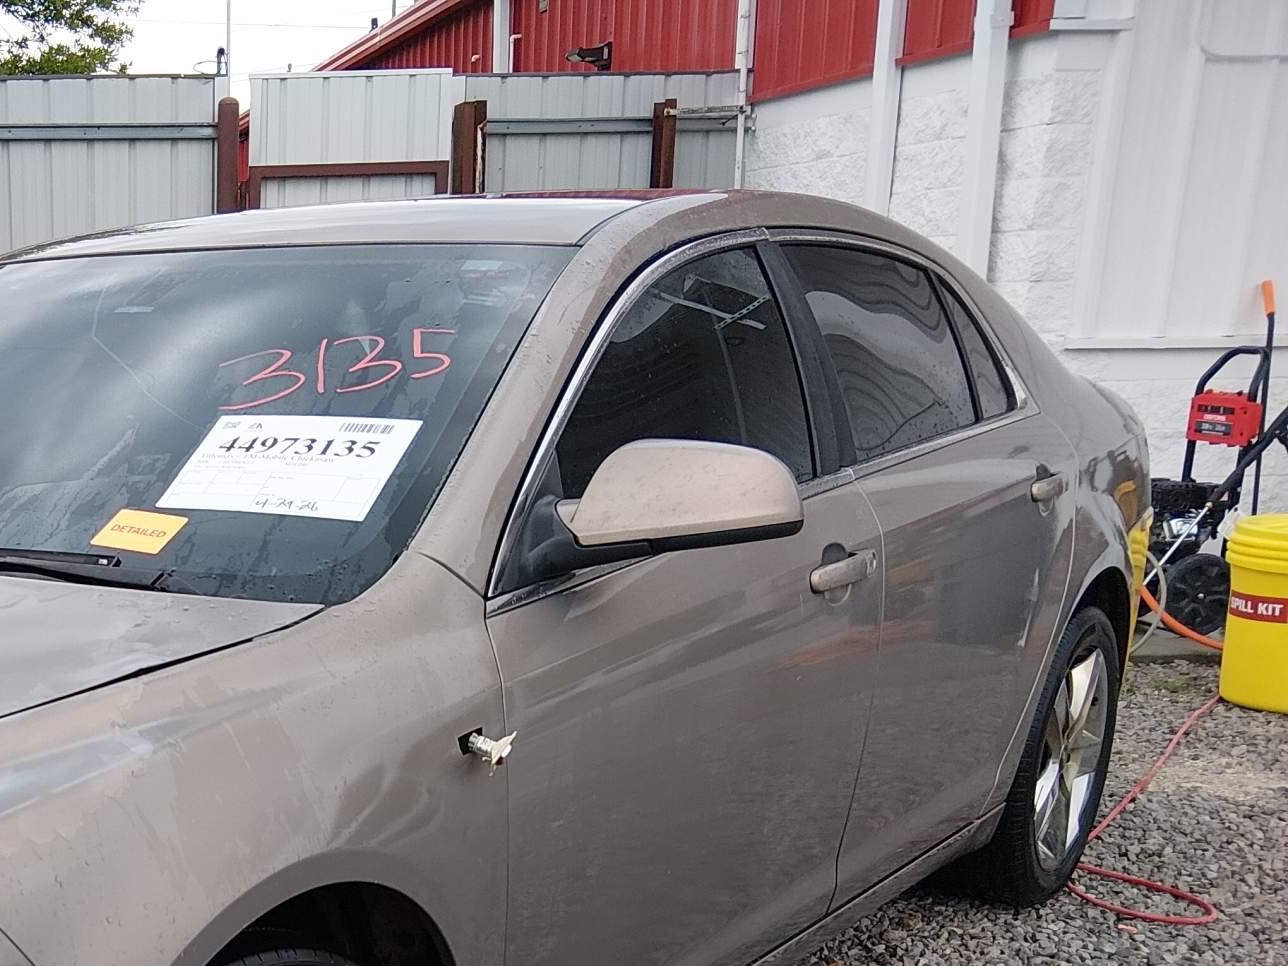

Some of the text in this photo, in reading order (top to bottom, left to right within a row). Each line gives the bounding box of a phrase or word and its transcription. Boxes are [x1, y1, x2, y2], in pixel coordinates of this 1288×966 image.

[217, 327, 457, 411] 3135
[218, 436, 382, 459] 44973135
[110, 523, 168, 539] DETAILED
[1257, 602, 1285, 616] KIT
